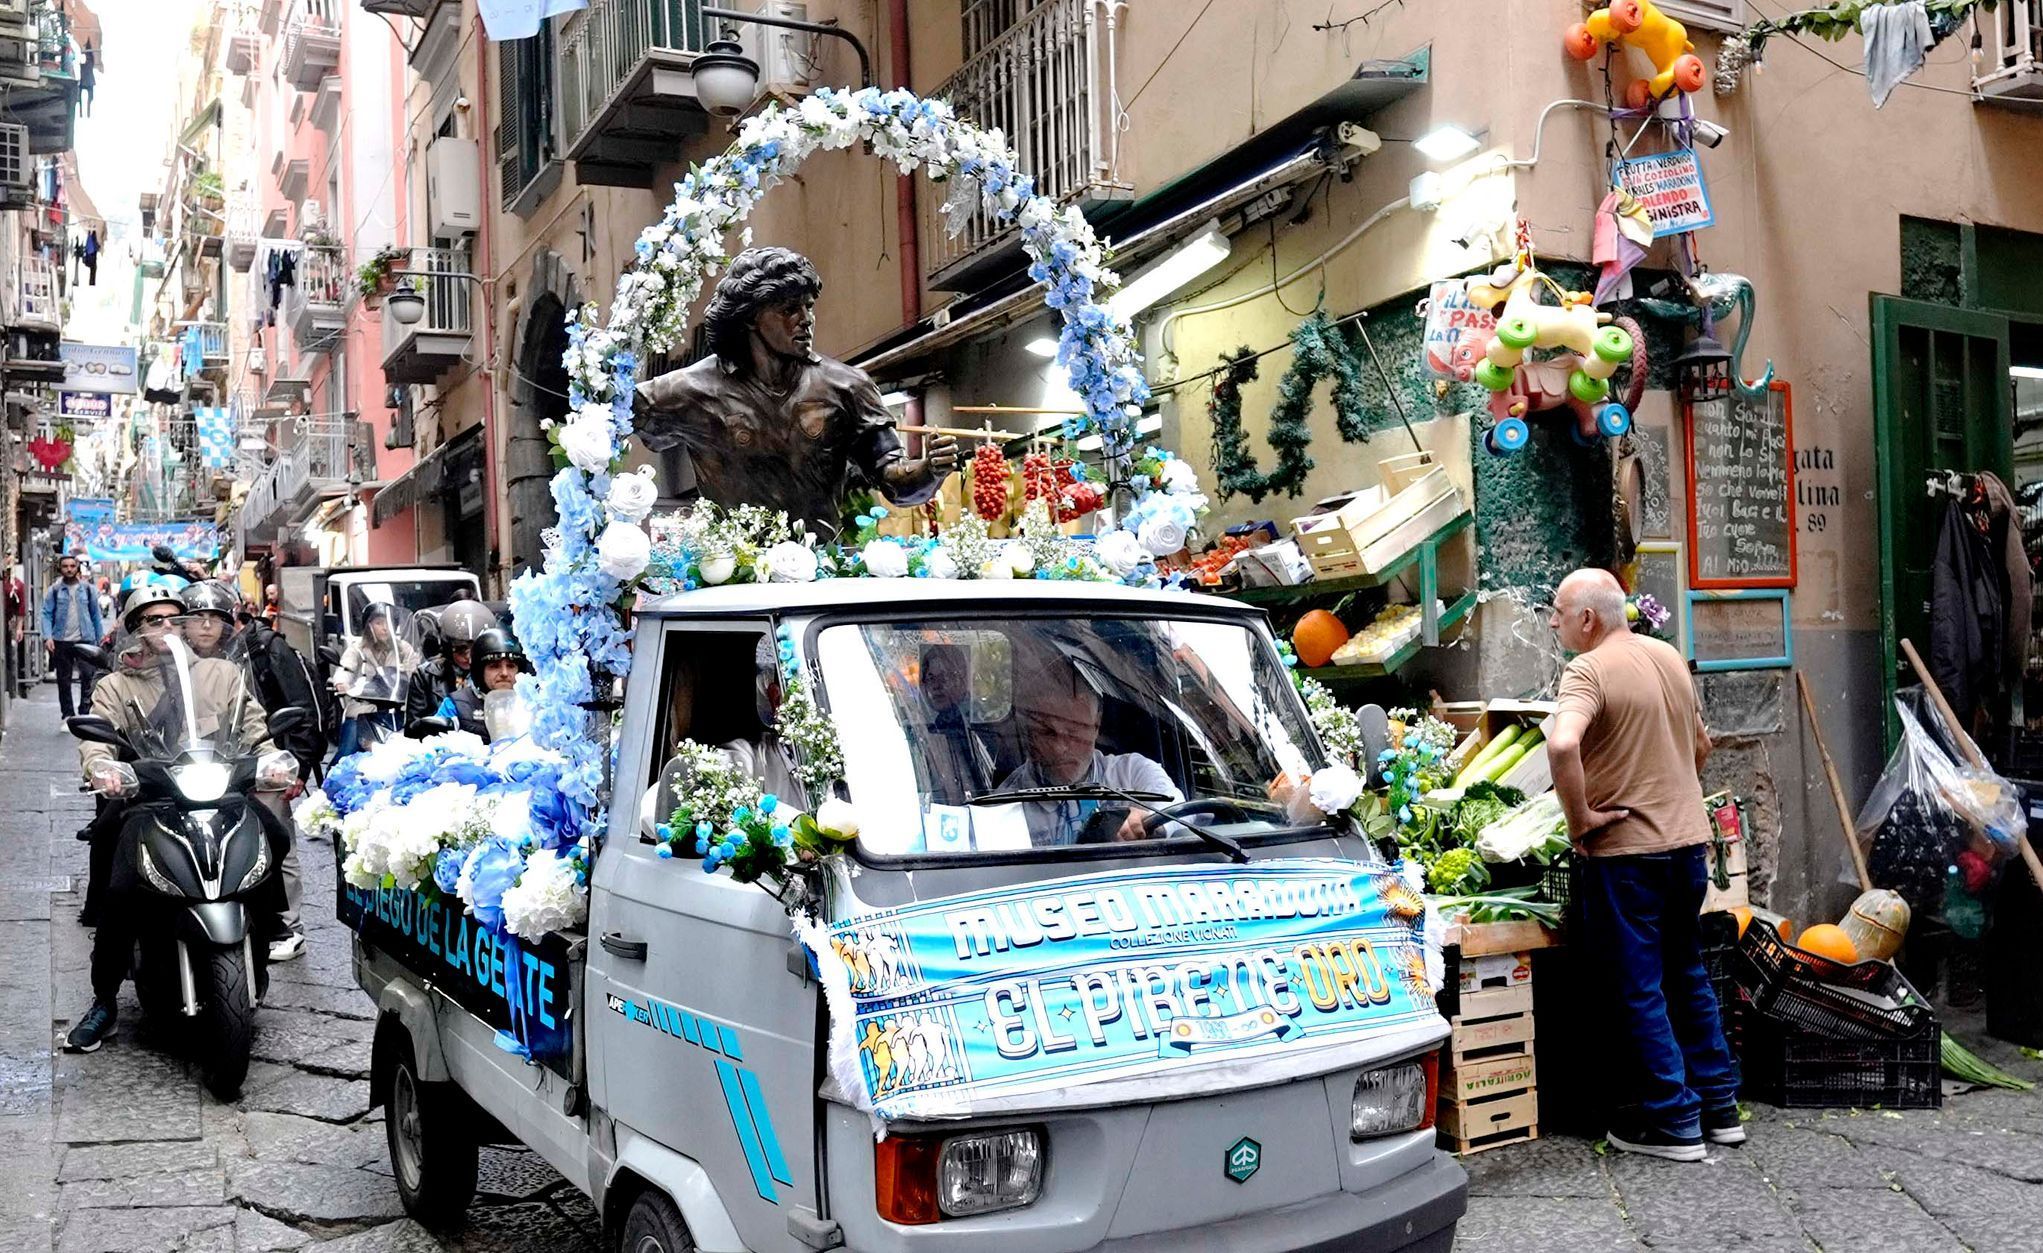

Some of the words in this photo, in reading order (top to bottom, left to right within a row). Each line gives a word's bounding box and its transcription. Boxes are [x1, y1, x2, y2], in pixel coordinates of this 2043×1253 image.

[1637, 189, 1688, 208] ALENDO
[1703, 420, 1740, 437] uanto
[1808, 513, 1827, 532] 89
[944, 886, 1138, 962] MUSEO
[1131, 878, 1365, 931] MARADONA
[1110, 930, 1190, 950] COLLEZIONE
[1191, 926, 1238, 944] VIGNATI
[416, 892, 441, 956] DE
[444, 907, 471, 976] LA
[474, 926, 555, 1030] GETE
[984, 978, 1078, 1060] EL
[1292, 937, 1391, 1014] ORO
